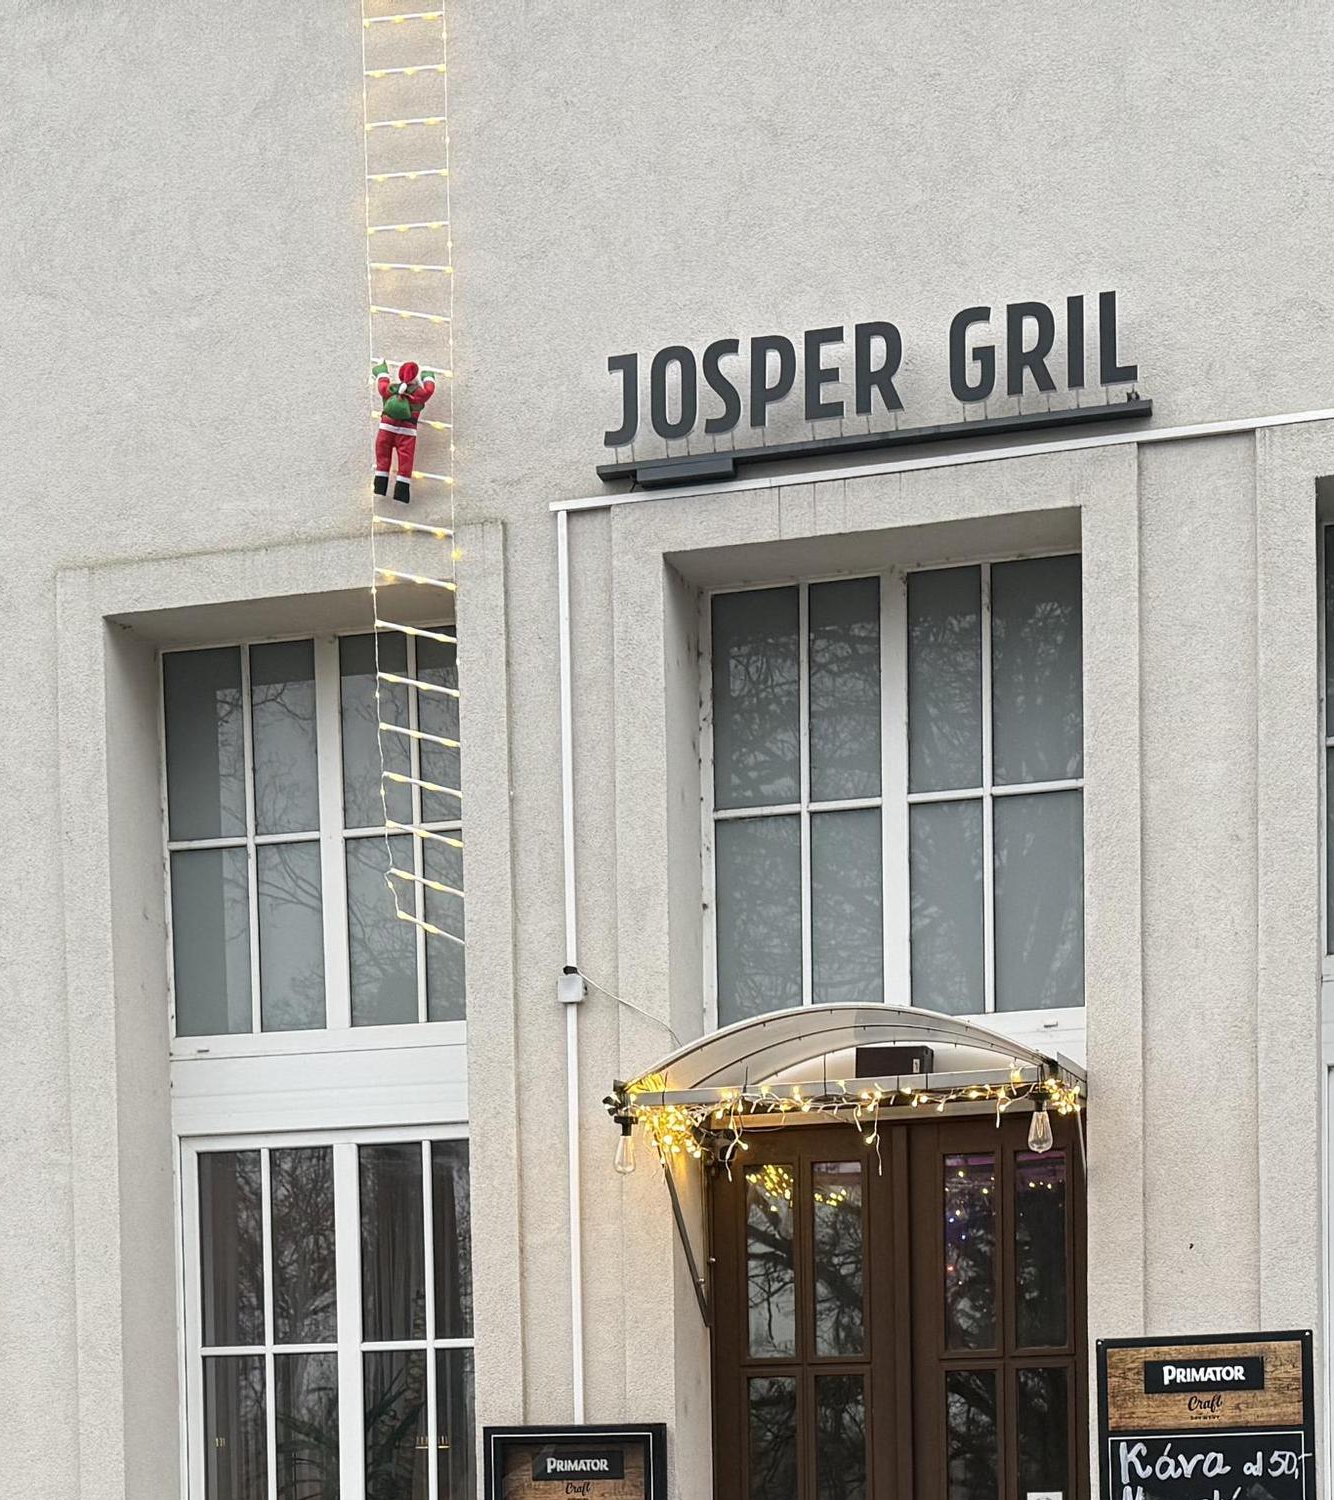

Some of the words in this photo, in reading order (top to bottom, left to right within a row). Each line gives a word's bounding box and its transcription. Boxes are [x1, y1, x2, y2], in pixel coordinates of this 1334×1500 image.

[604, 321, 903, 447] JOSPER
[948, 291, 1138, 402] GRIL
[1163, 1365, 1245, 1385] PRIMATOR
[1188, 1394, 1223, 1412] Craft
[546, 1457, 609, 1474] PRIMATOR
[1119, 1441, 1231, 1484] Káva
[1243, 1451, 1263, 1477] od
[565, 1481, 591, 1496] Craft
